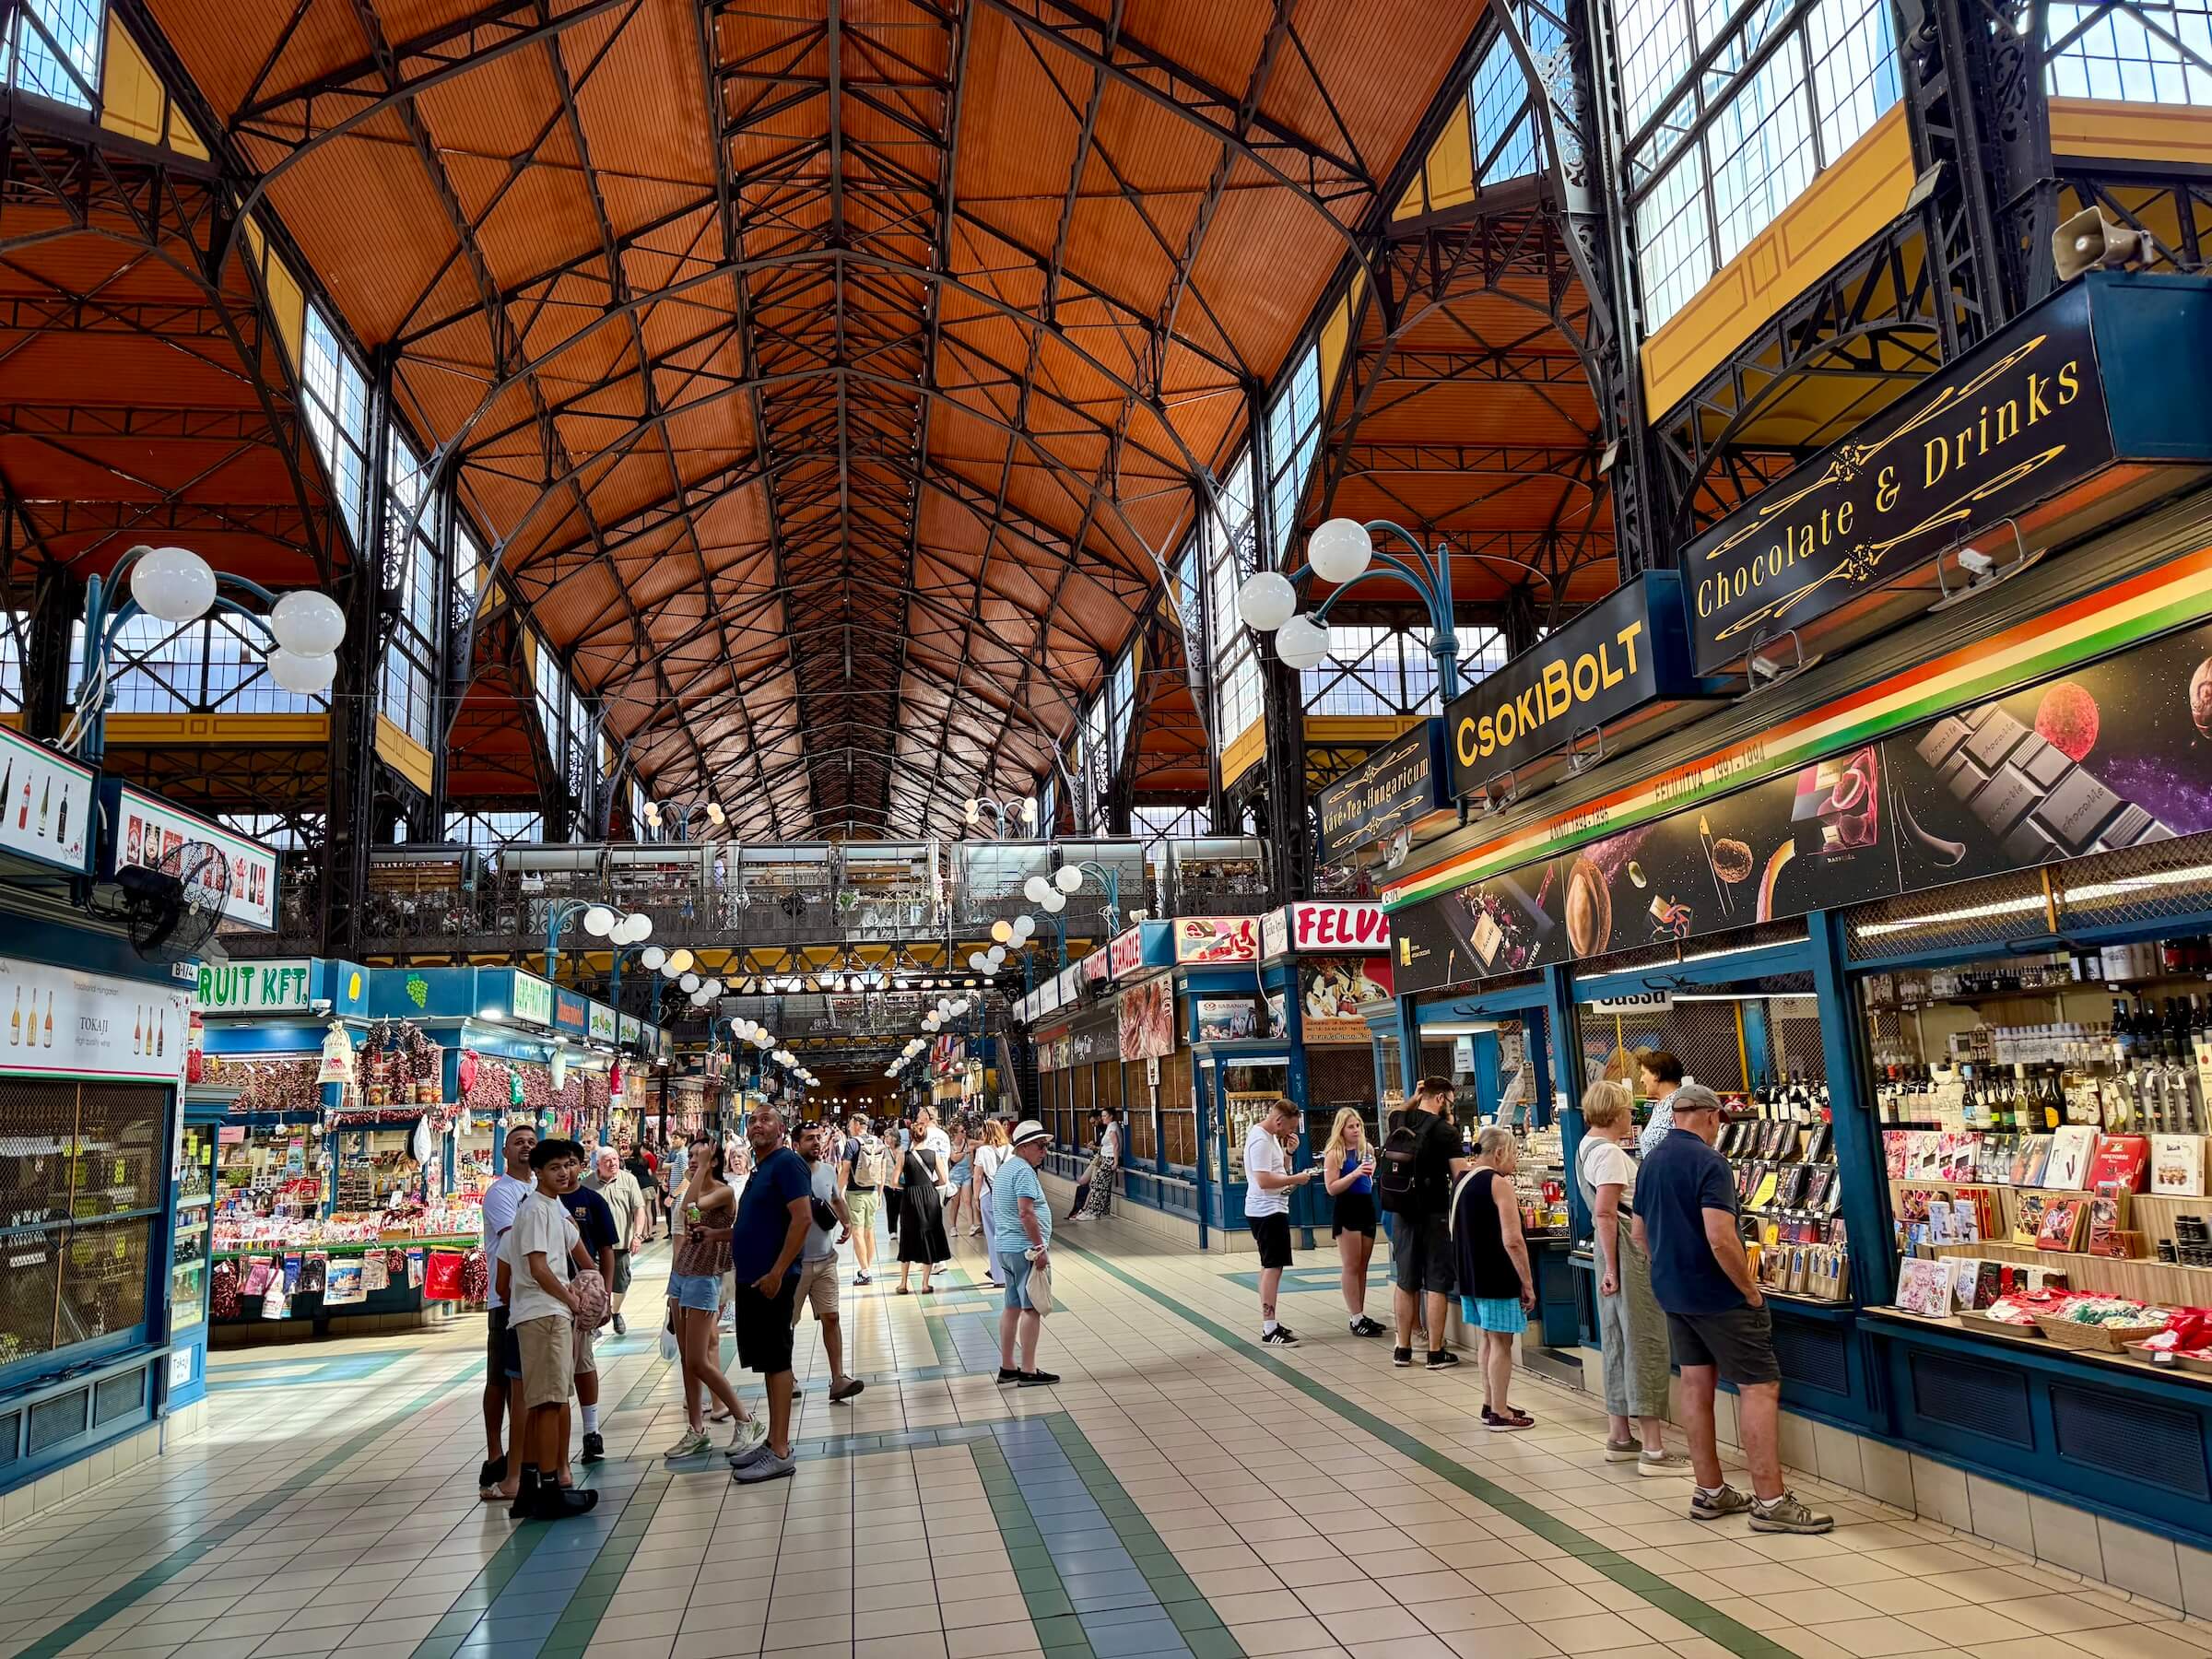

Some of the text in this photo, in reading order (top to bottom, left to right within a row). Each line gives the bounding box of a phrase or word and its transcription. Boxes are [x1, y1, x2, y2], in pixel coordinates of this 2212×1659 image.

[1698, 359, 2080, 618] Chocolate & Drinks
[260, 967, 308, 1005] KFT.
[79, 1017, 109, 1036] TOKAJI
